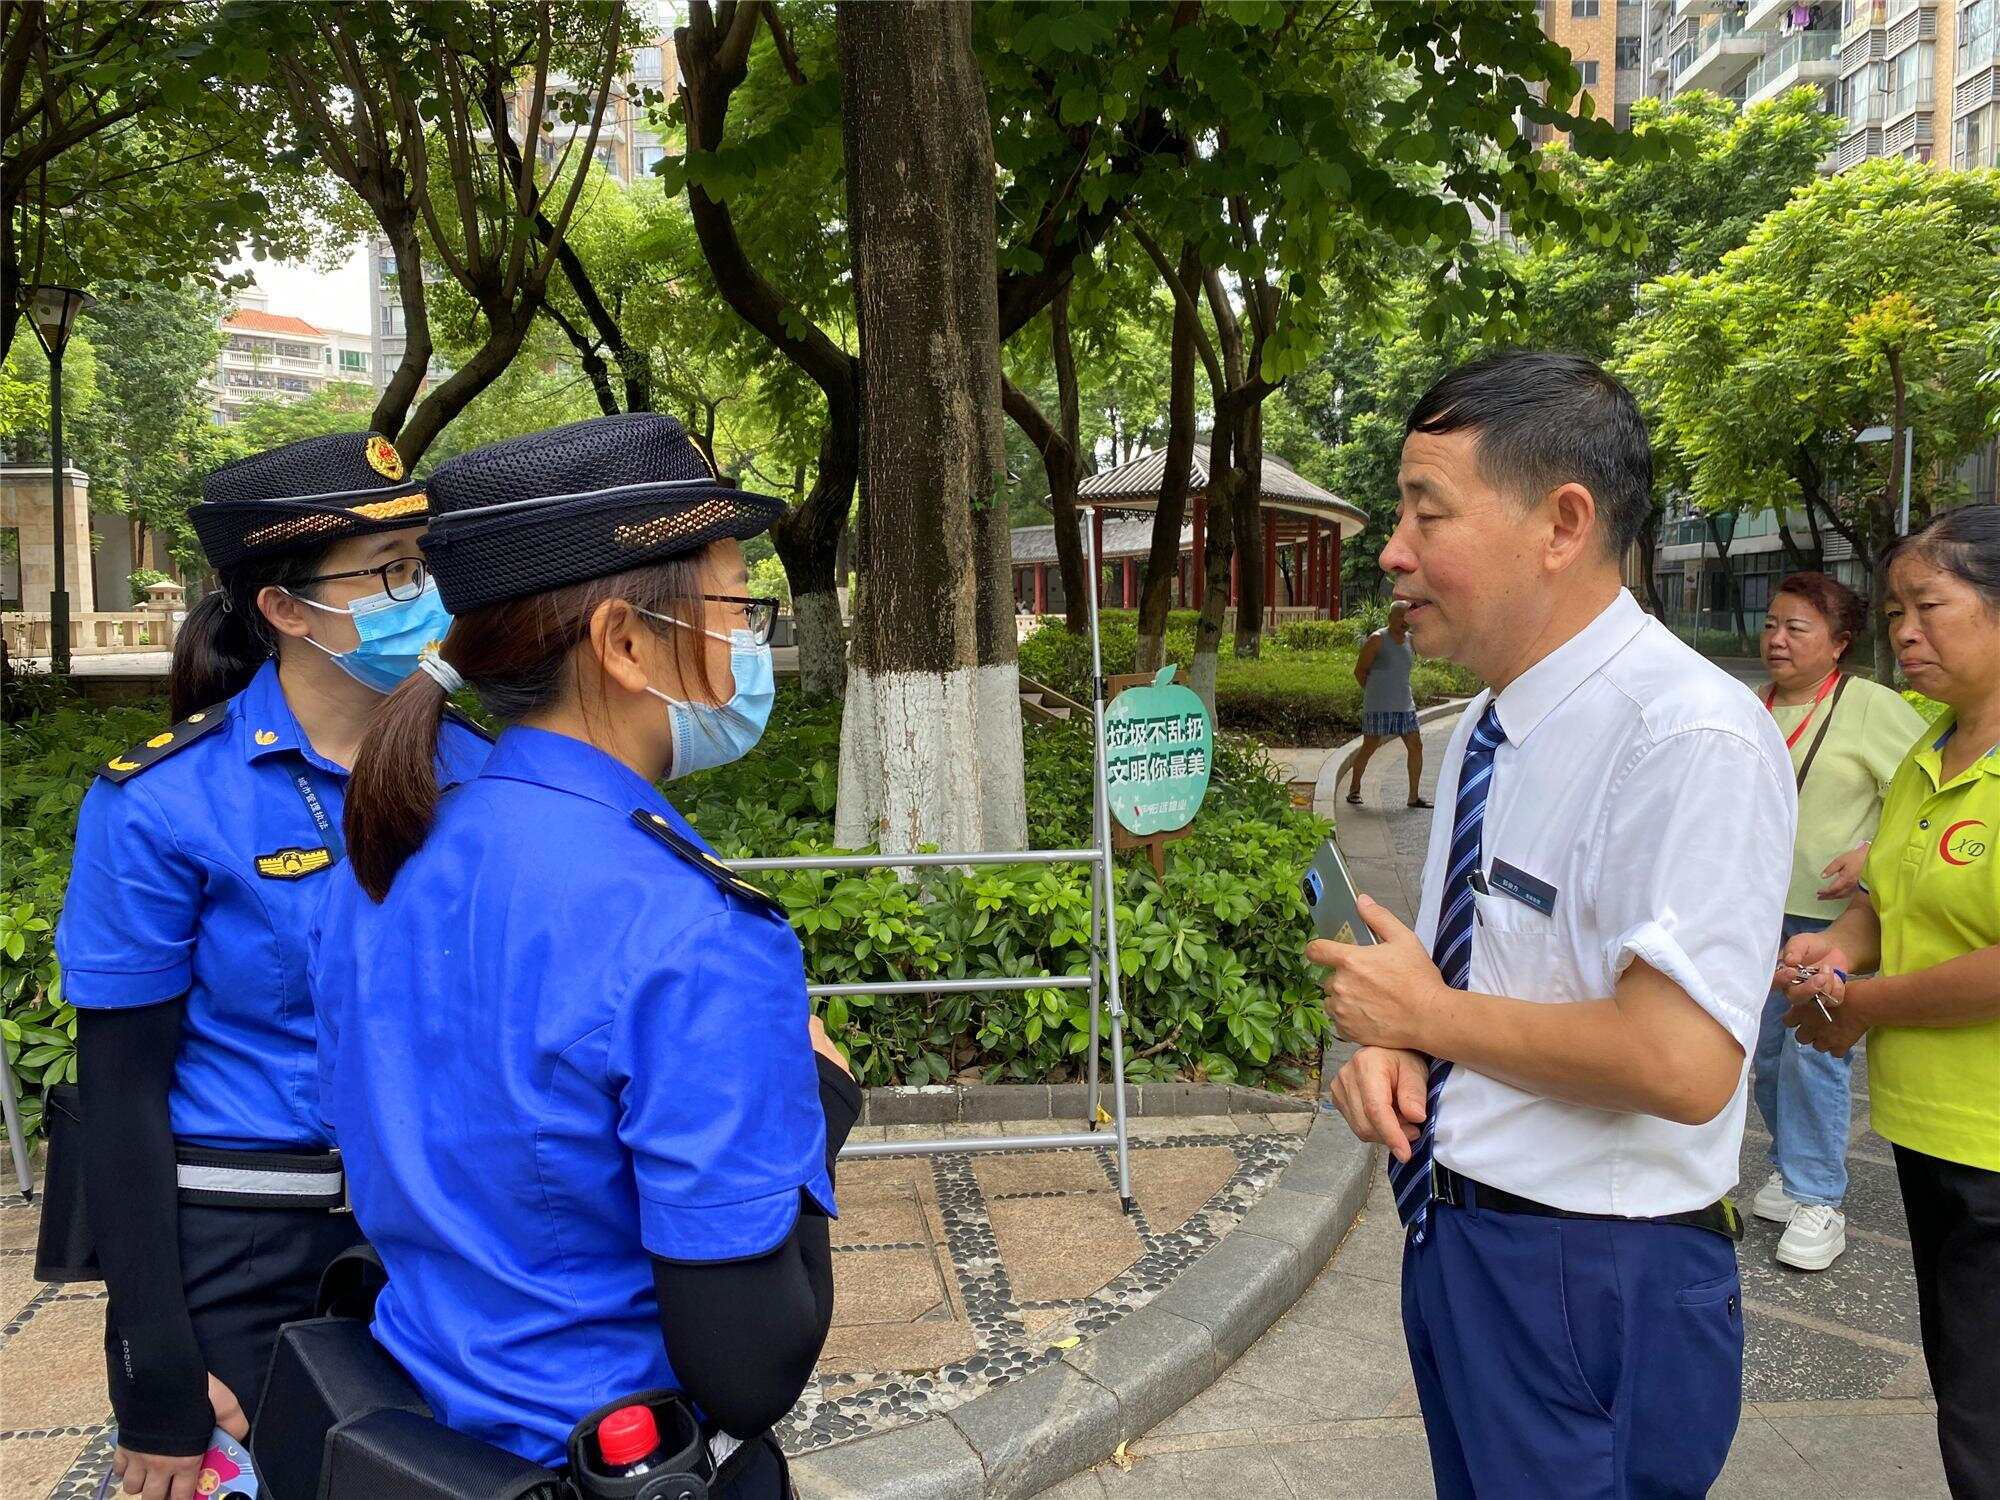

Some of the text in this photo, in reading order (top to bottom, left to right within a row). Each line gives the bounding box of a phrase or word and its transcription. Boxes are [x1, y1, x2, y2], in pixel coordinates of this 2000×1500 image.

[1106, 714, 1204, 748] 垃圾不乱扔
[1107, 750, 1206, 787] 文明你最美
[297, 777, 329, 831] 城市管理执法
